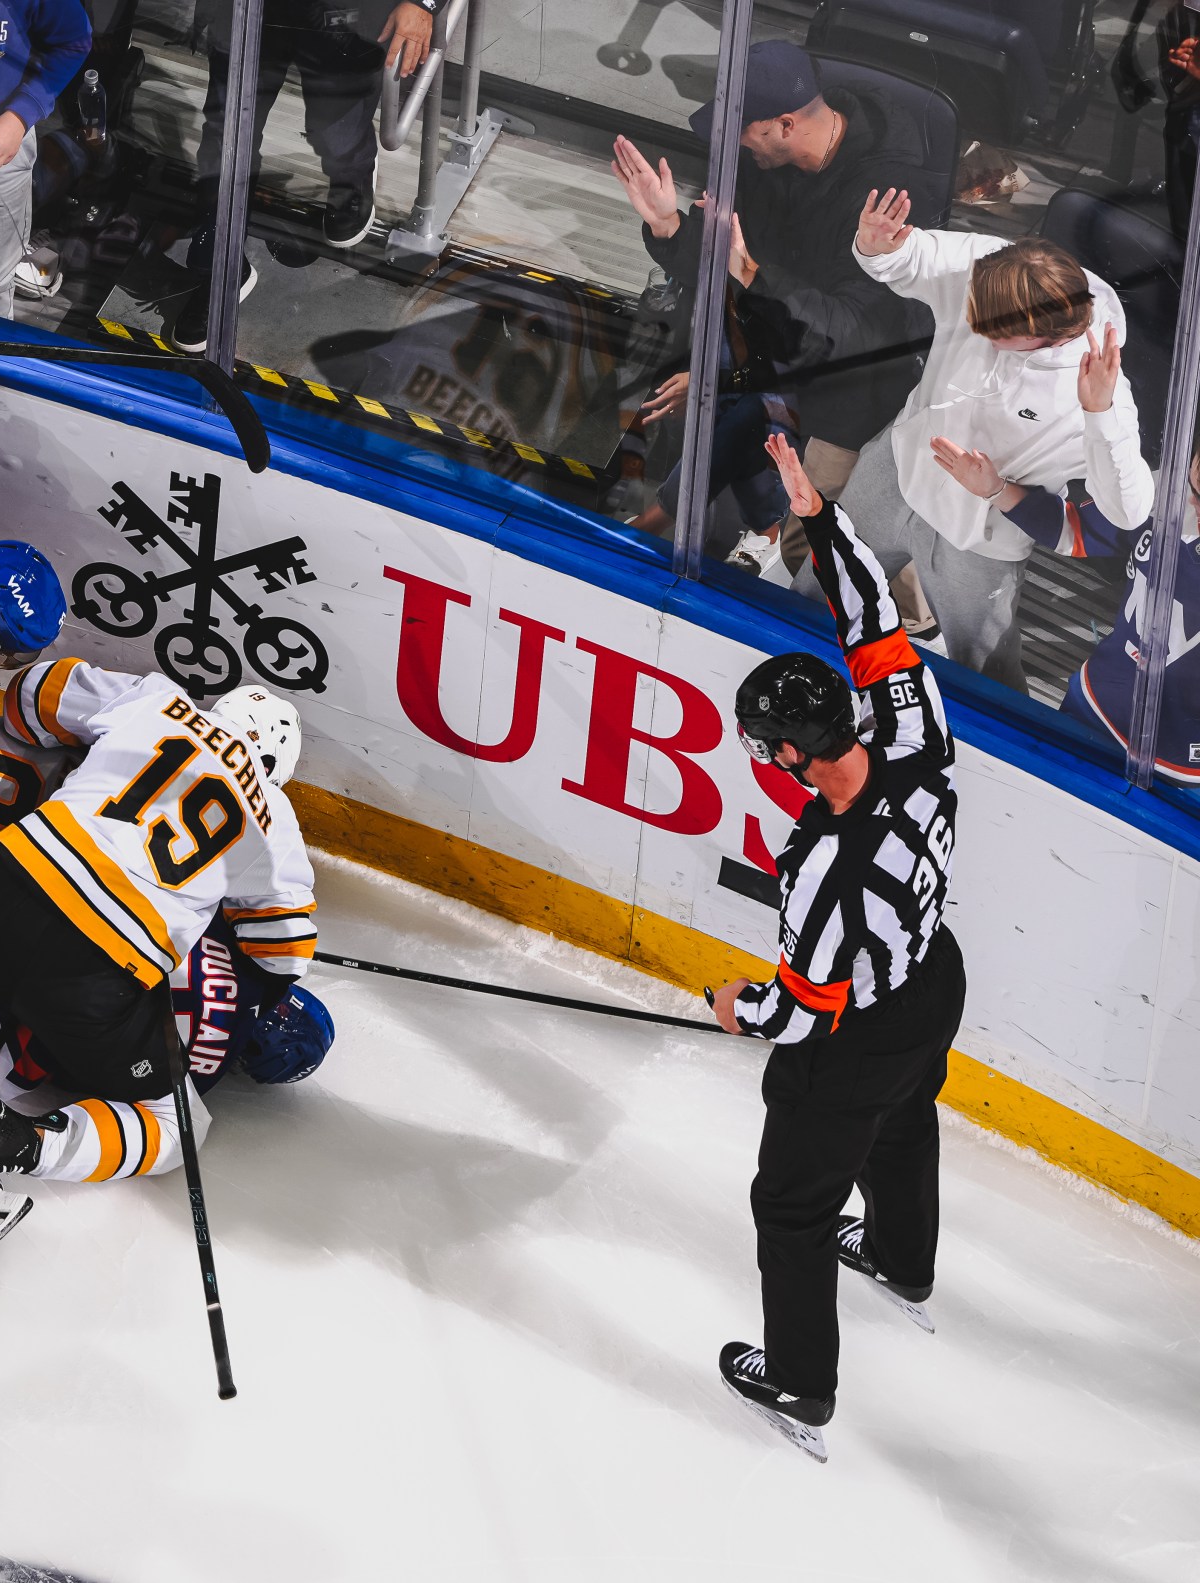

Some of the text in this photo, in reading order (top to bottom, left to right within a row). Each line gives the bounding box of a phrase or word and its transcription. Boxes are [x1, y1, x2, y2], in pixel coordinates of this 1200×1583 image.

[7, 573, 35, 619] VIAM
[248, 692, 267, 702] 19
[889, 682, 920, 708] 36
[93, 735, 247, 891] 19
[912, 814, 953, 912] 36
[342, 959, 360, 969] DUCLAIR
[186, 935, 238, 1076] DUCLAIR
